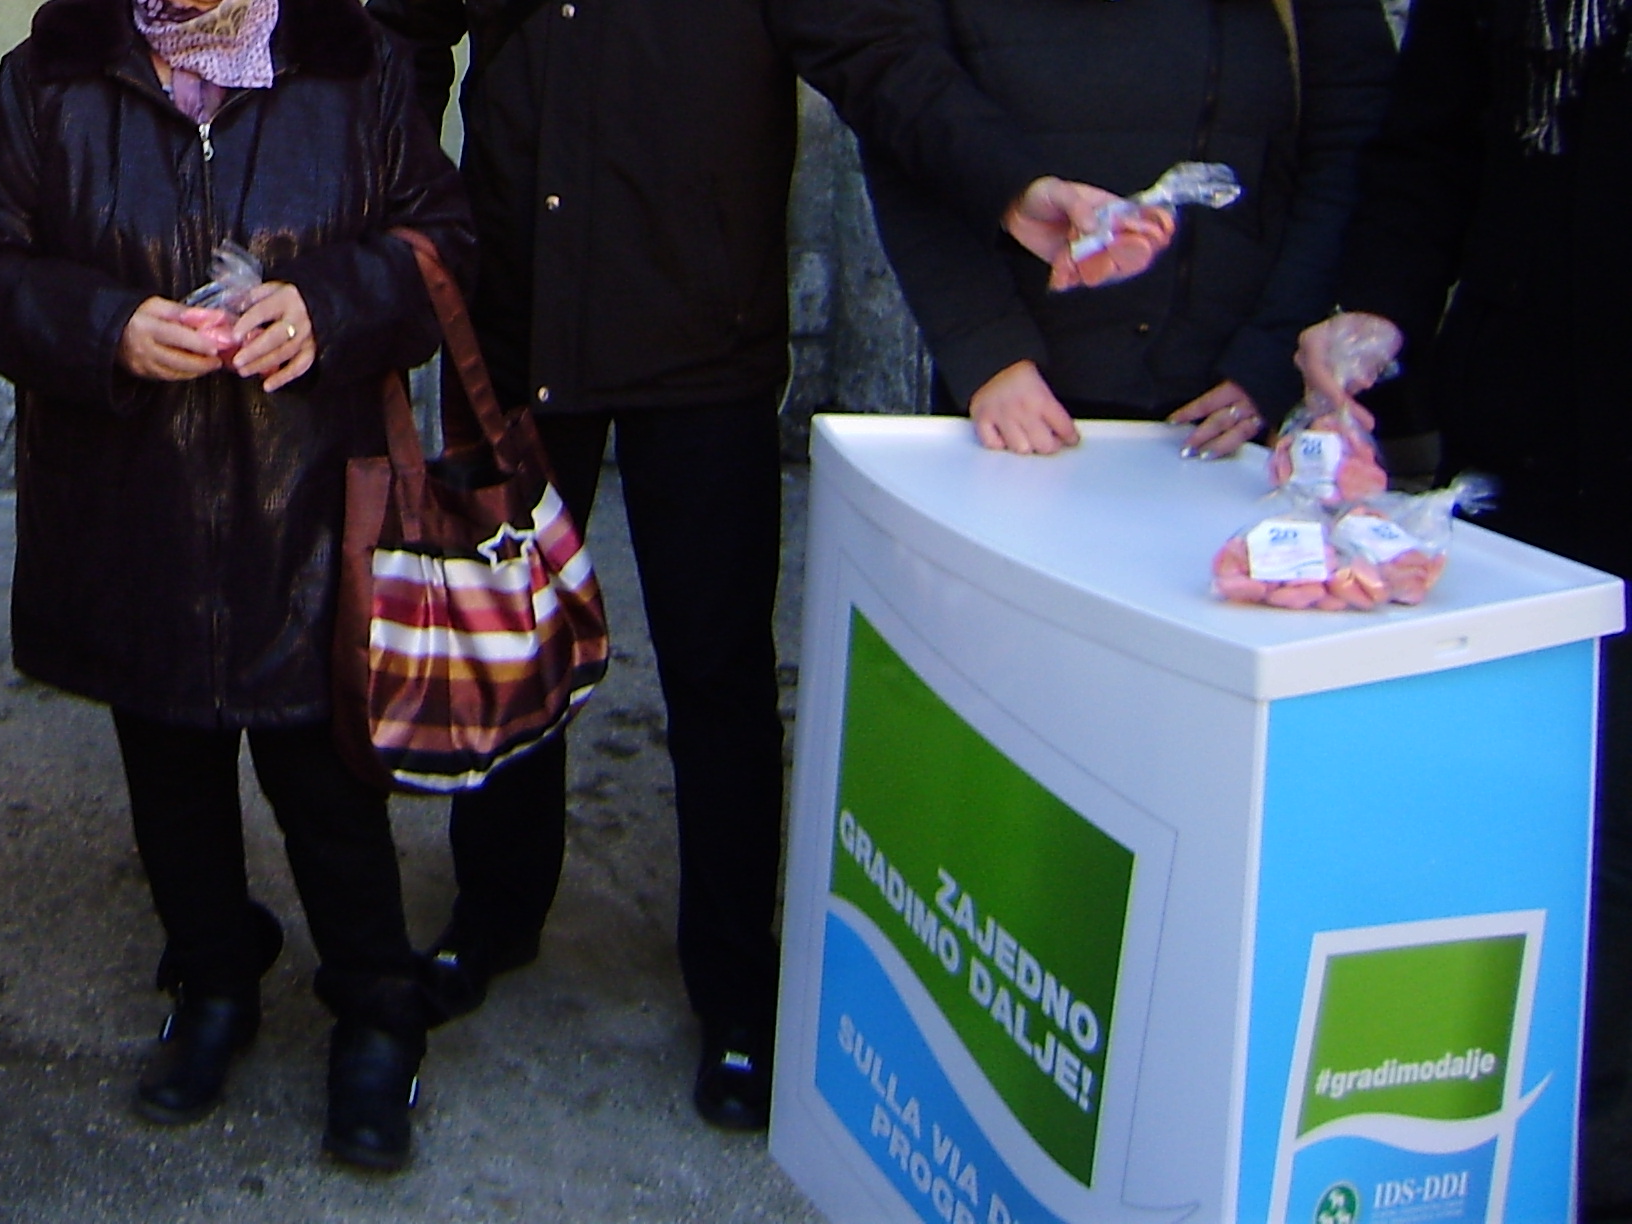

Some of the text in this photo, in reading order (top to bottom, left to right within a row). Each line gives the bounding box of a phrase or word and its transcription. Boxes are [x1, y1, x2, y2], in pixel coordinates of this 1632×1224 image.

[838, 809, 1094, 1112] GRADIMO DALJE!
[934, 866, 1101, 1054] ZAJEDNO
[837, 1013, 921, 1139] SULLA
[931, 1122, 979, 1207] VIA
[1315, 1047, 1496, 1099] #gradimodalje
[1373, 1171, 1469, 1208] IDS-DDI
